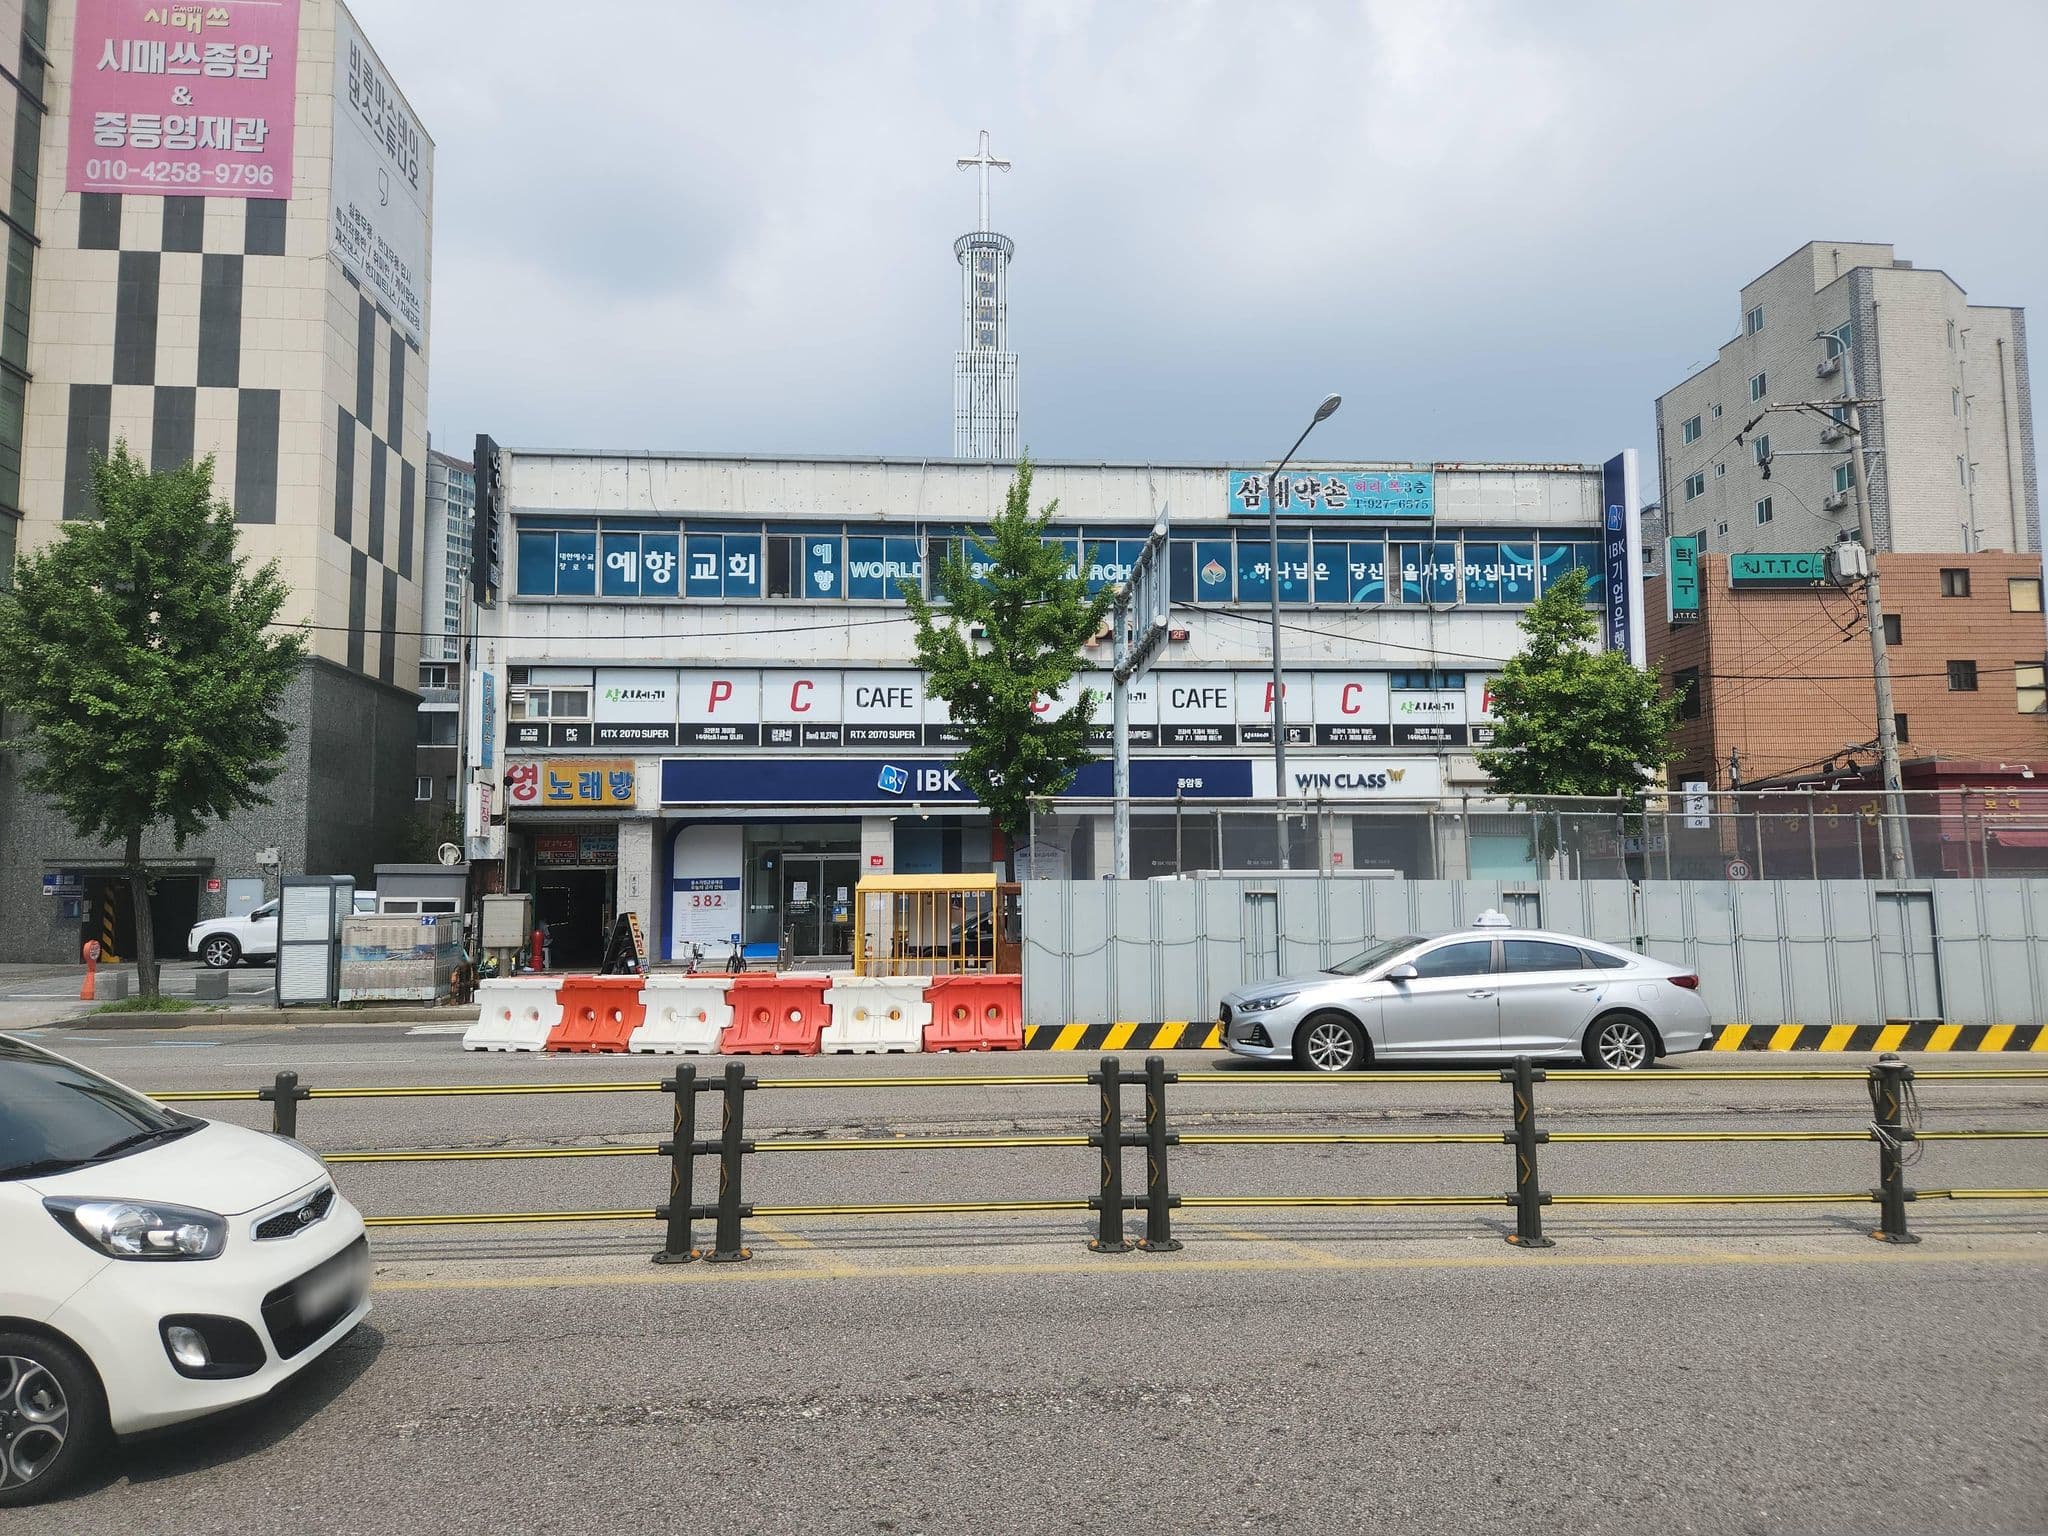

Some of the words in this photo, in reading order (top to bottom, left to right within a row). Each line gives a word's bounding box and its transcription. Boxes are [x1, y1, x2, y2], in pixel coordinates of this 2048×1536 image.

[144, 7, 229, 33] 시매쓰
[96, 38, 273, 79] 시매쓰종암
[171, 86, 193, 106] &
[93, 112, 269, 152] 중등영재관
[349, 72, 418, 191] 댄스스튜디오
[86, 158, 274, 185] 010-4258-9796
[1354, 480, 1381, 494] 허리
[1405, 480, 1427, 494] 3층
[1354, 498, 1430, 510] T:927-6575
[1609, 539, 1625, 559] IBK
[607, 551, 756, 585] 예향교회
[812, 543, 834, 591] 예향
[850, 561, 923, 579] WORLD
[1254, 562, 1330, 580] 하나님은
[1676, 548, 1695, 594] 탁구
[1752, 559, 1813, 573] J.T.T.C.
[1612, 560, 1625, 650] 기업은행
[707, 680, 733, 712] P
[790, 680, 813, 712] C
[856, 687, 914, 709] CAFE
[1172, 687, 1227, 709] CAFE
[1263, 681, 1287, 713] P
[1341, 683, 1363, 714] C
[566, 728, 578, 737] PC
[601, 730, 618, 738] RTX
[619, 730, 640, 738] 2070
[641, 730, 669, 738] SUPER
[850, 730, 866, 739] RTX
[868, 730, 888, 739] 2070
[889, 730, 916, 739] SUPER
[1290, 729, 1300, 737] PC
[507, 763, 538, 800] 영
[548, 771, 634, 800] 노래방
[917, 769, 961, 792] IBK
[1177, 778, 1203, 788] 종암동
[1295, 773, 1331, 789] WIN
[1335, 773, 1386, 789] CLASS
[1732, 864, 1745, 877] 30
